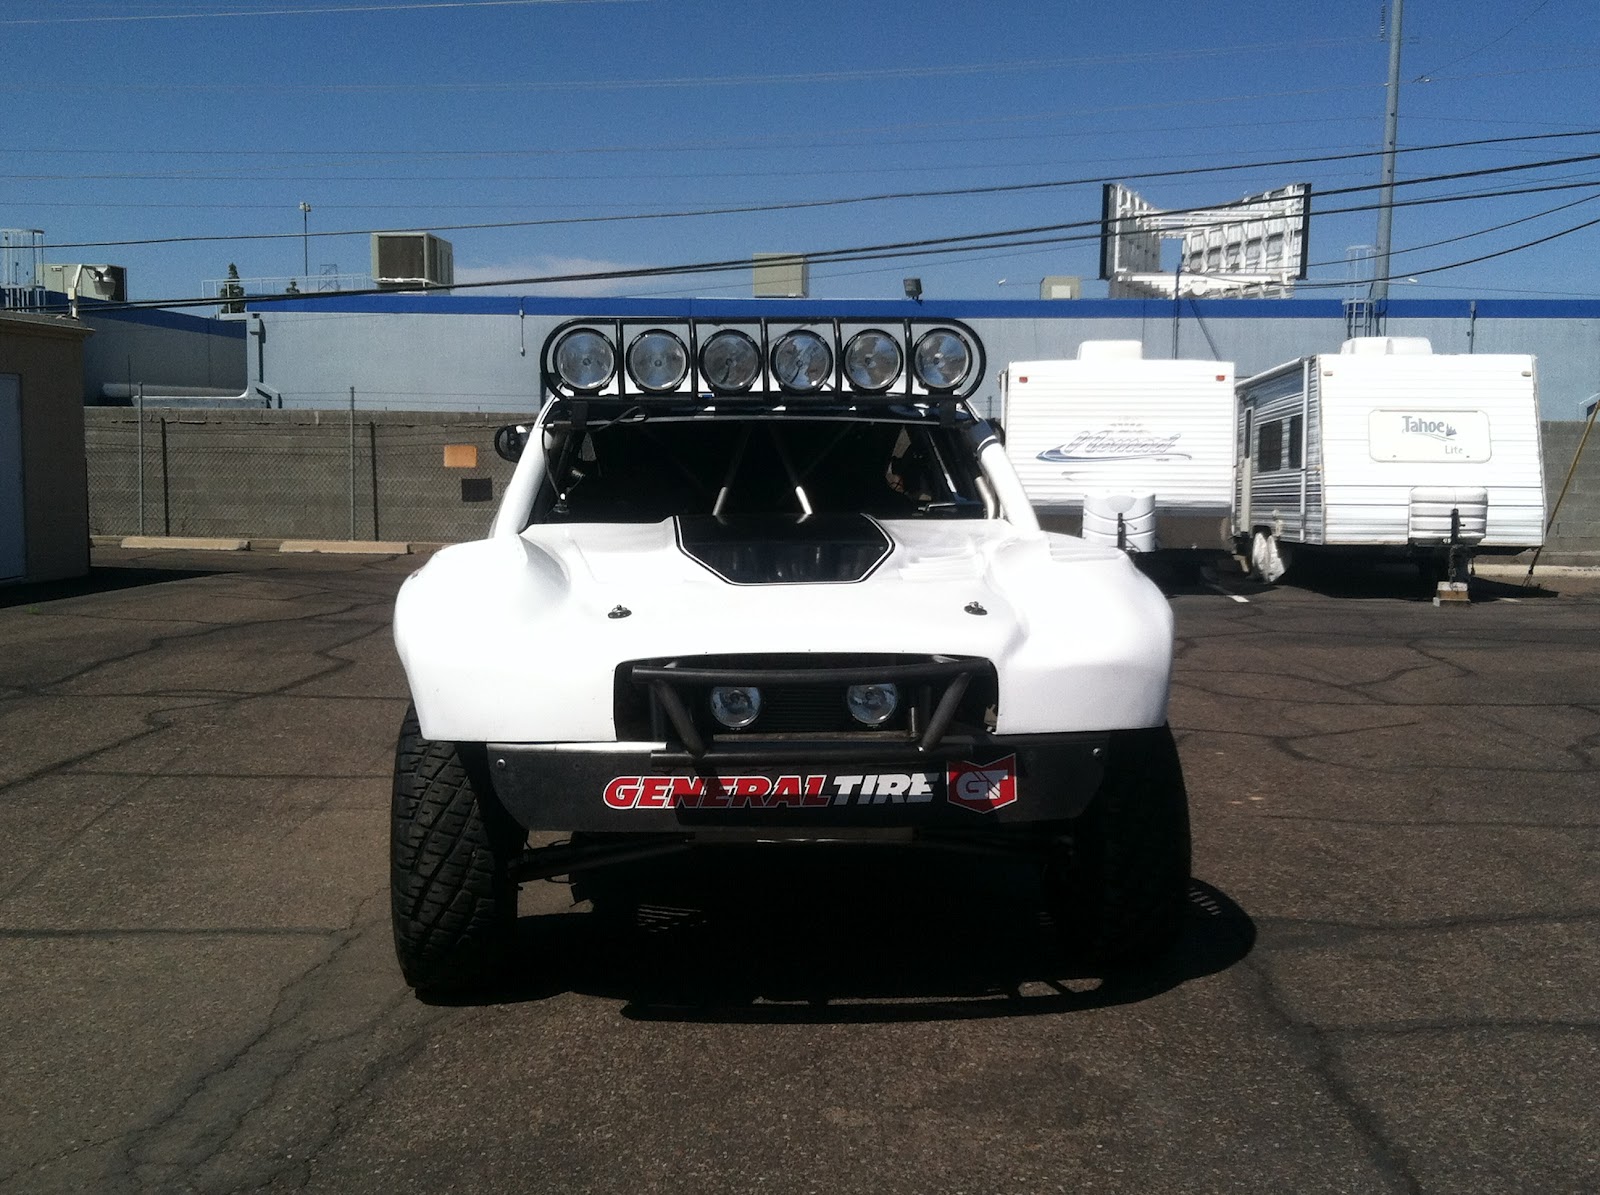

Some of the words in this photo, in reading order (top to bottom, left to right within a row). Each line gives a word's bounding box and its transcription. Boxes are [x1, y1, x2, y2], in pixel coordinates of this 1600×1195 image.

[1401, 415, 1445, 433] Tahoe
[1444, 445, 1463, 454] Lite
[603, 775, 829, 809] GENERAL
[832, 772, 939, 806] TIRE
[956, 769, 1009, 801] GT
